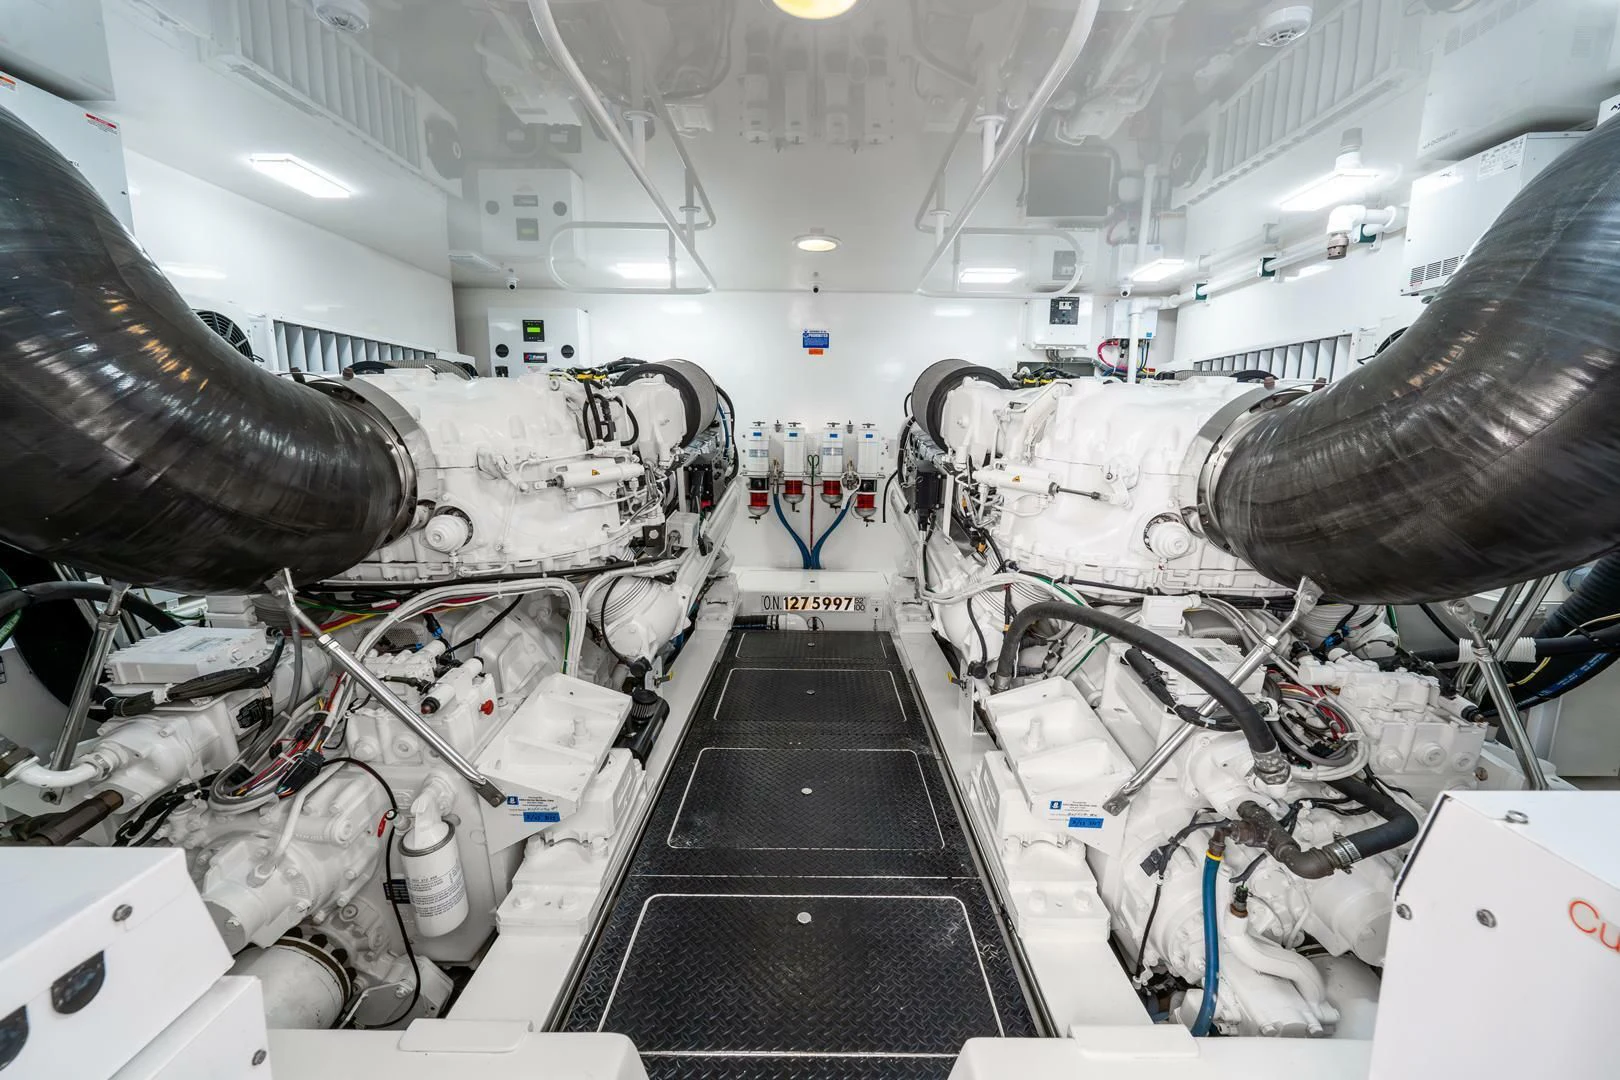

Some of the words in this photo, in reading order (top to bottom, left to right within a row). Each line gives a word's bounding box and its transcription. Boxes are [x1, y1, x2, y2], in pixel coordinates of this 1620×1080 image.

[763, 595, 782, 610] O.N.
[783, 597, 853, 610] 1275997
[1569, 900, 1620, 953] Cu
